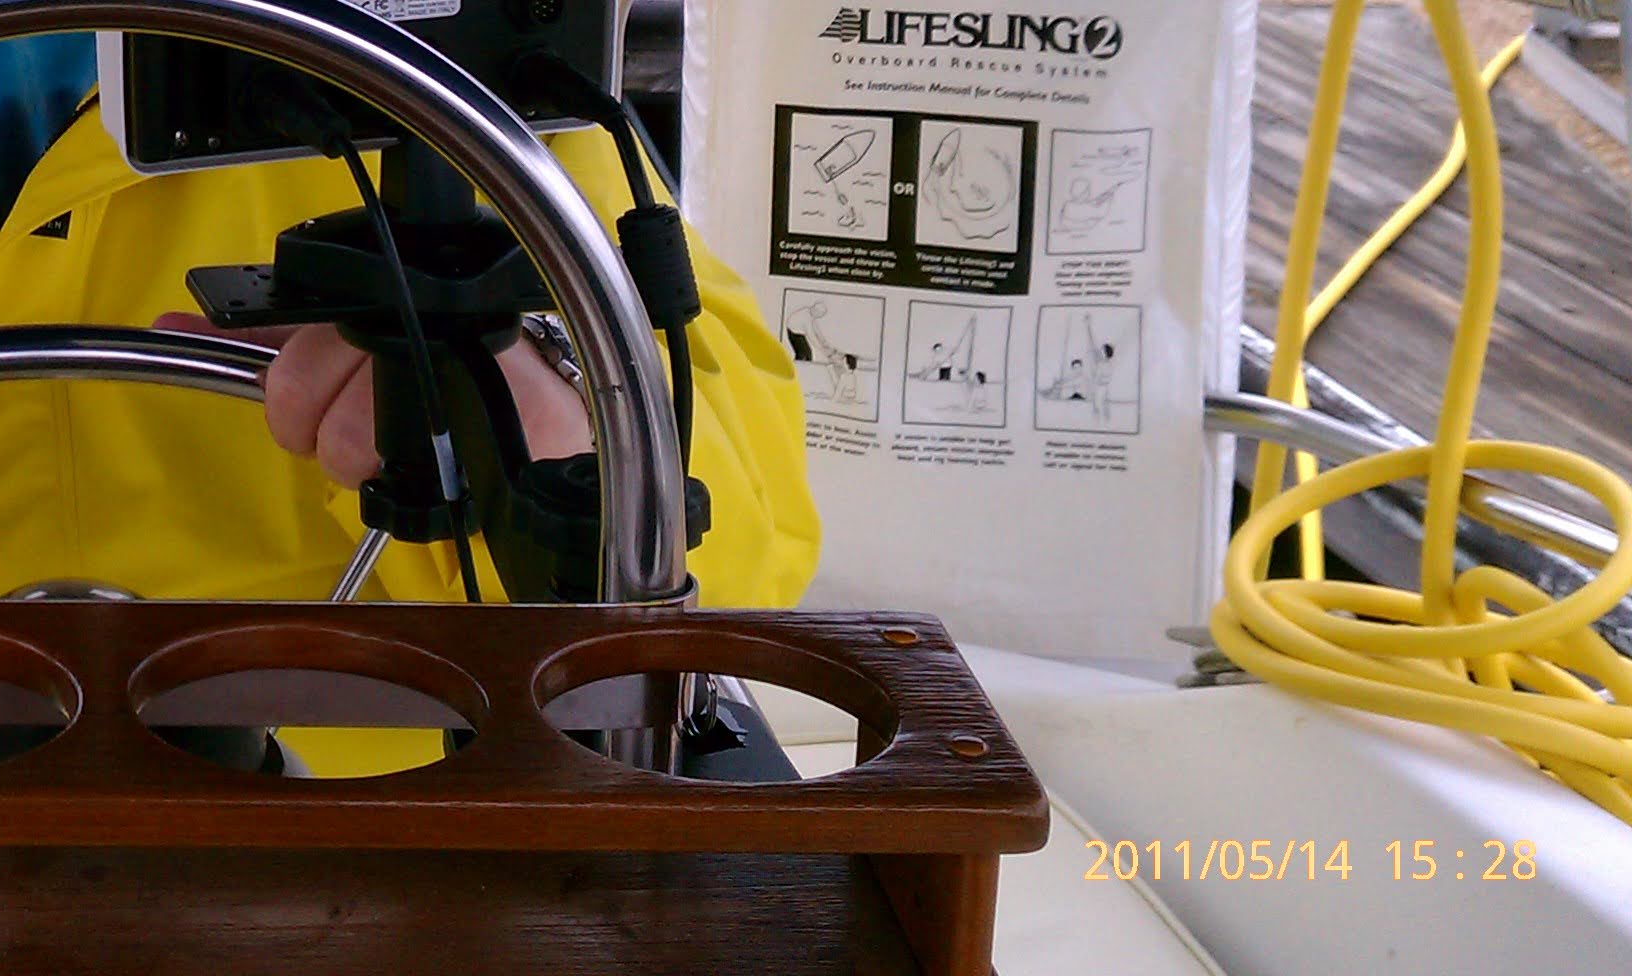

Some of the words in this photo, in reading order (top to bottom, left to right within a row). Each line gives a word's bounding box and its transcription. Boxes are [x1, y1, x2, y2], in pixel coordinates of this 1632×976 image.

[857, 8, 1080, 55] LIFESLING
[832, 52, 937, 67] Overboard
[950, 57, 1022, 73] Rescue
[1035, 62, 1108, 79] System
[844, 79, 863, 91] See
[867, 80, 925, 93] Instruction
[928, 82, 971, 96] Manual
[974, 85, 990, 99] for
[994, 87, 1047, 103] Complete
[1051, 91, 1090, 104] Details
[893, 182, 915, 196] OR
